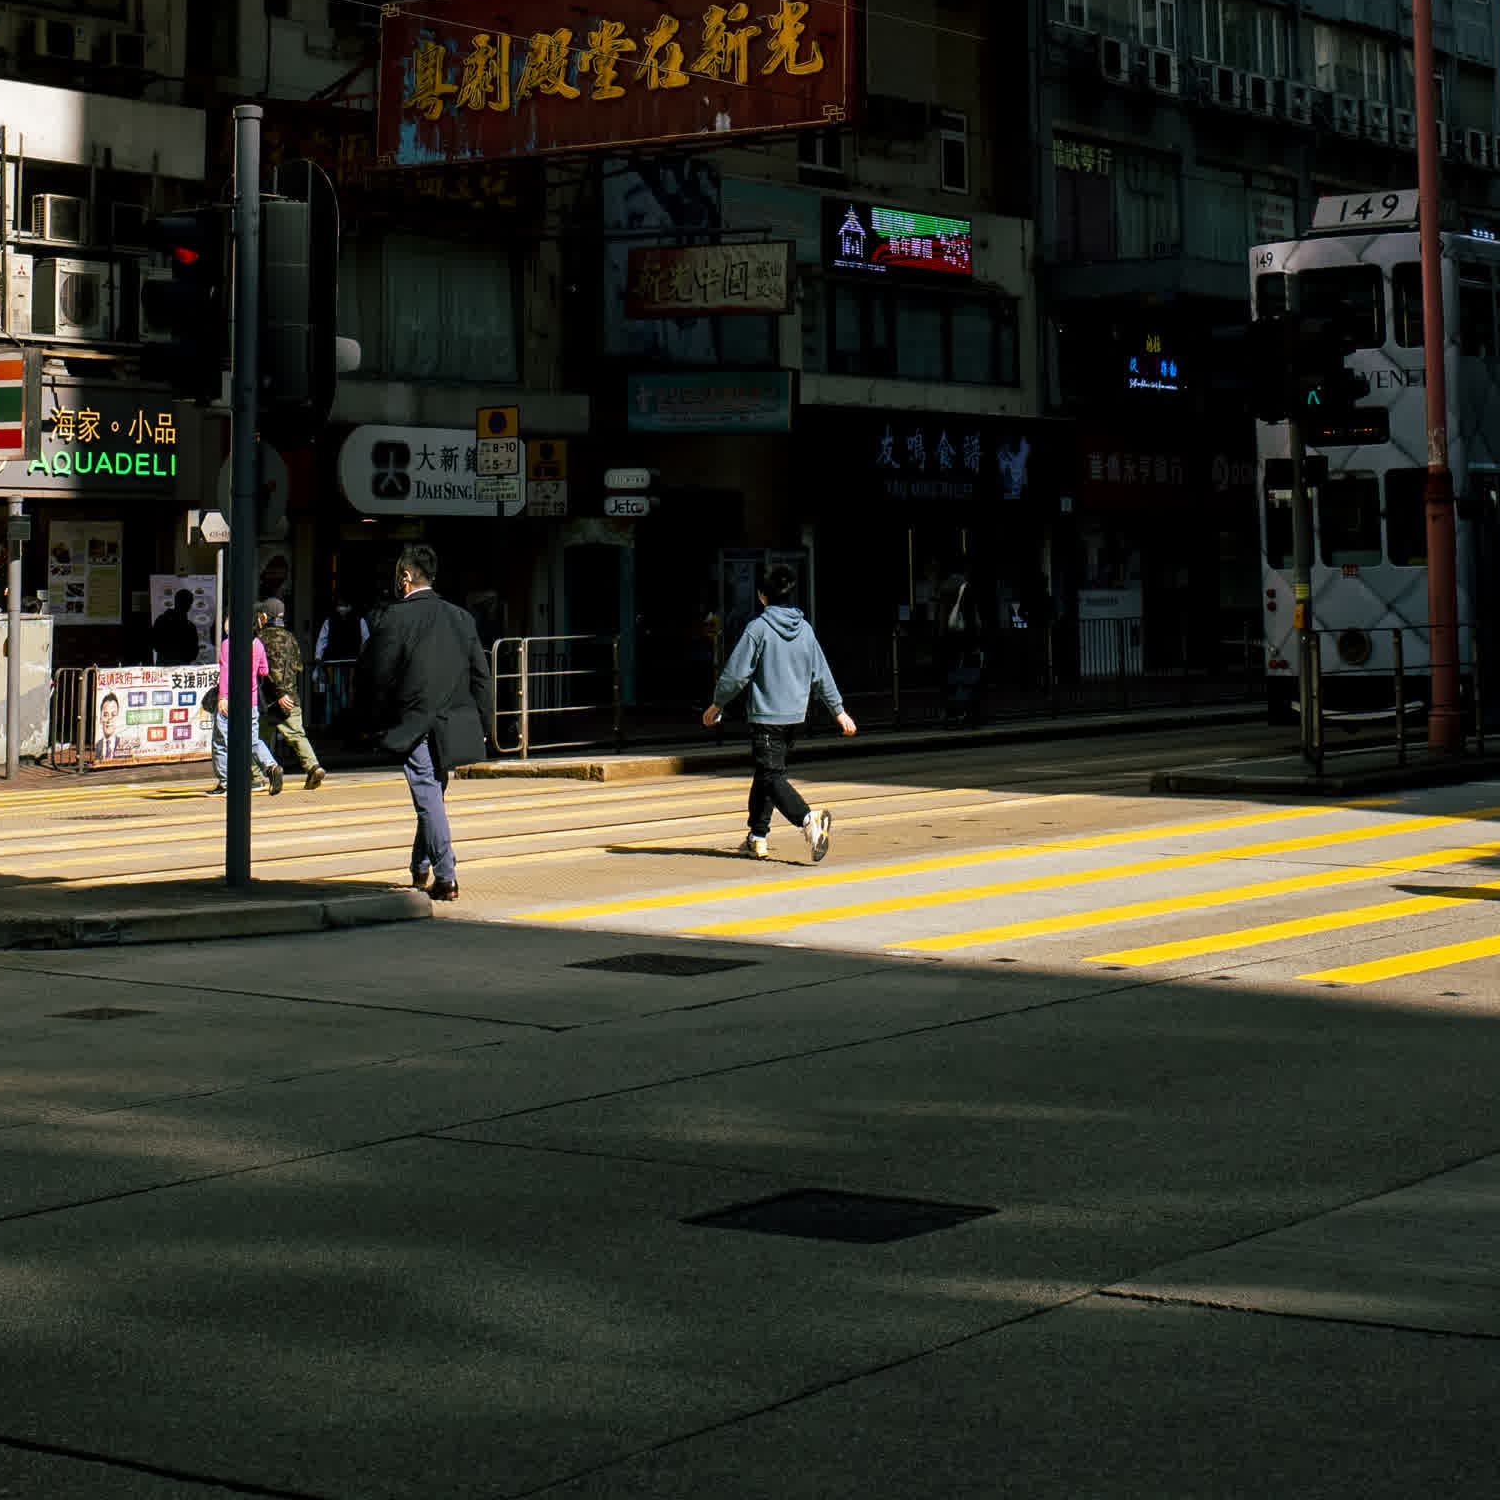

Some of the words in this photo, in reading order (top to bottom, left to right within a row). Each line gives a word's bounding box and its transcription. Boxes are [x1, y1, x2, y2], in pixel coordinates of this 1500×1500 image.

[1340, 194, 1399, 222] 149
[1255, 252, 1273, 269] 149
[492, 442, 516, 453] 8-10
[28, 450, 177, 477] AQUADELI
